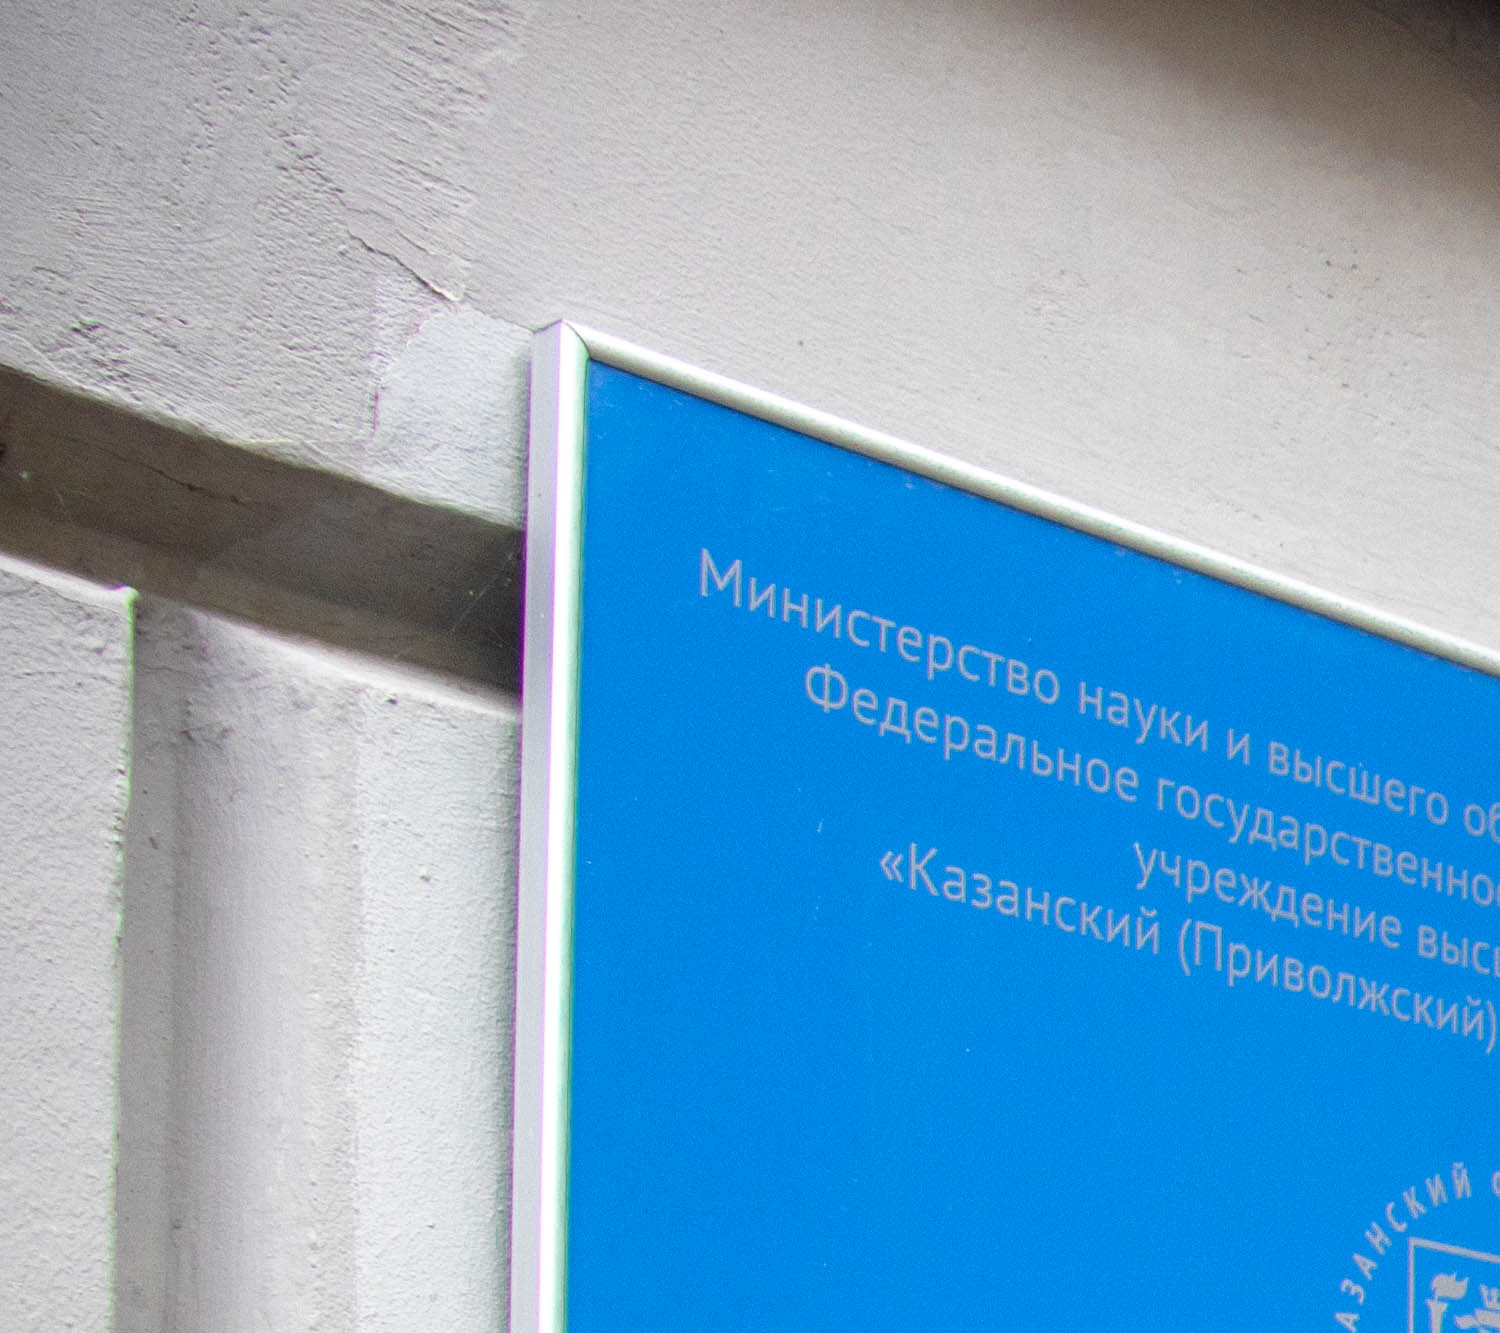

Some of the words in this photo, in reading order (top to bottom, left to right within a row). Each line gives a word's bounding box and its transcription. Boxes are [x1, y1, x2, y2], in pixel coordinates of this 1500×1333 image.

[699, 548, 1060, 705] Министерство
[1078, 682, 1208, 752] науки
[1227, 729, 1250, 765] и
[1268, 741, 1449, 825] высшего
[804, 663, 1139, 802] Федеральное
[879, 842, 1159, 954] «Казанский
[1178, 919, 1497, 1053] (Приволжский)
[1133, 842, 1402, 949] учреждение
